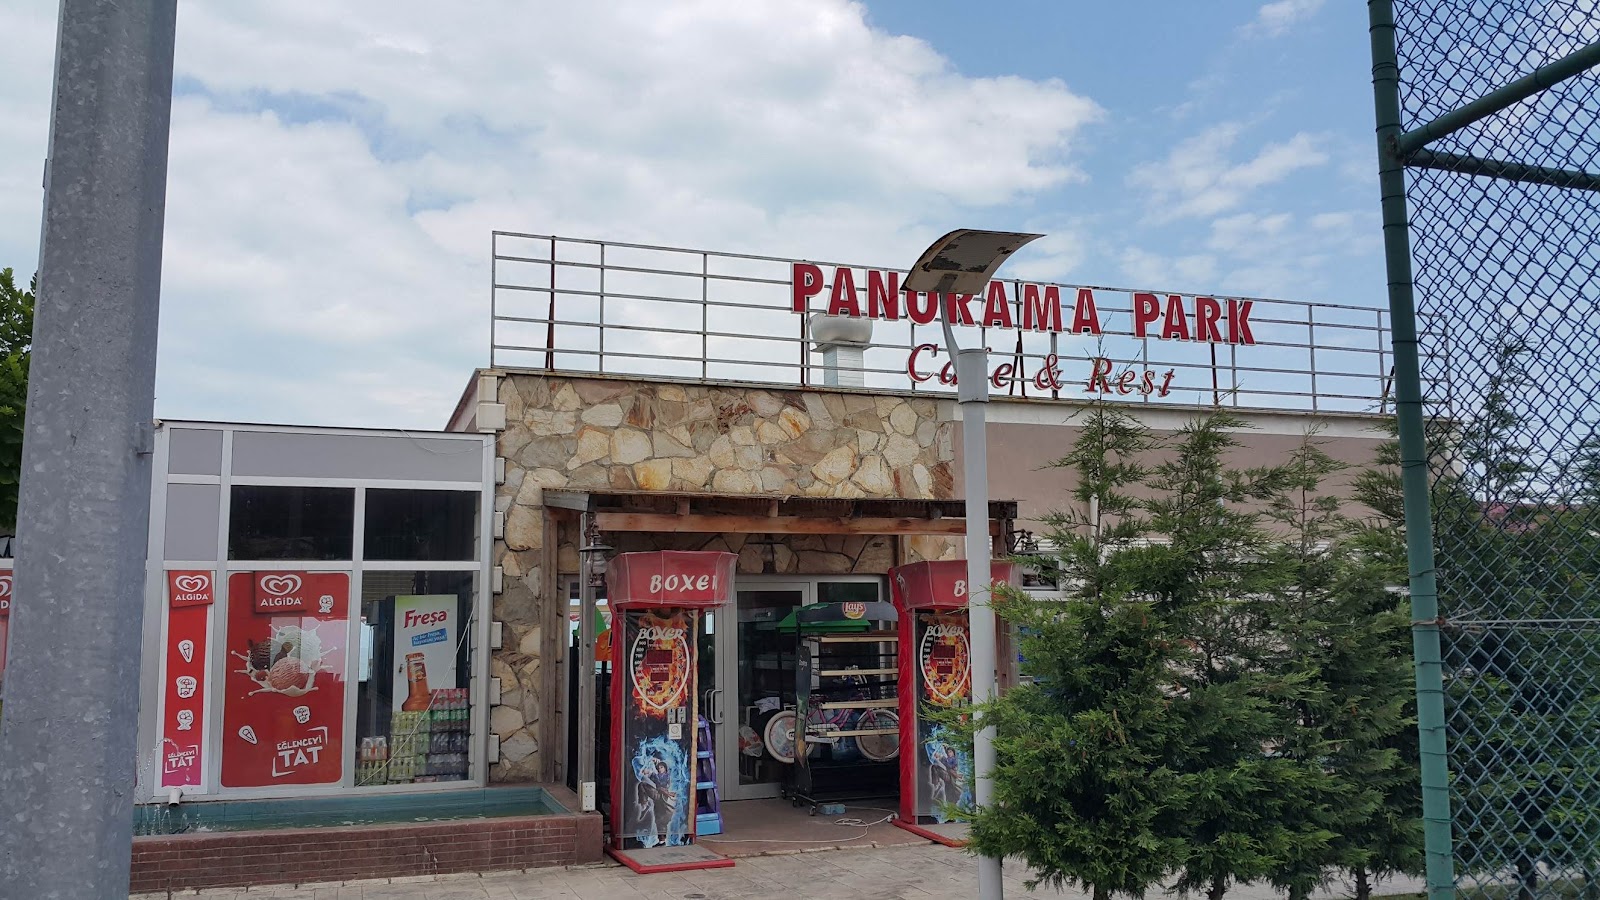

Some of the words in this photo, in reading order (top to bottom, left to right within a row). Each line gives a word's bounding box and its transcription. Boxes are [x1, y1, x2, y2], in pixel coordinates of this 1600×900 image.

[792, 262, 1101, 336] PANORAMA
[1133, 291, 1256, 346] PARK
[906, 343, 1013, 388] Cae
[1033, 353, 1063, 390] &
[1083, 357, 1175, 397] Rest
[639, 626, 683, 640] BOXER
[926, 624, 965, 637] BOXER
[168, 756, 195, 768] TAT
[278, 746, 323, 768] TAT
